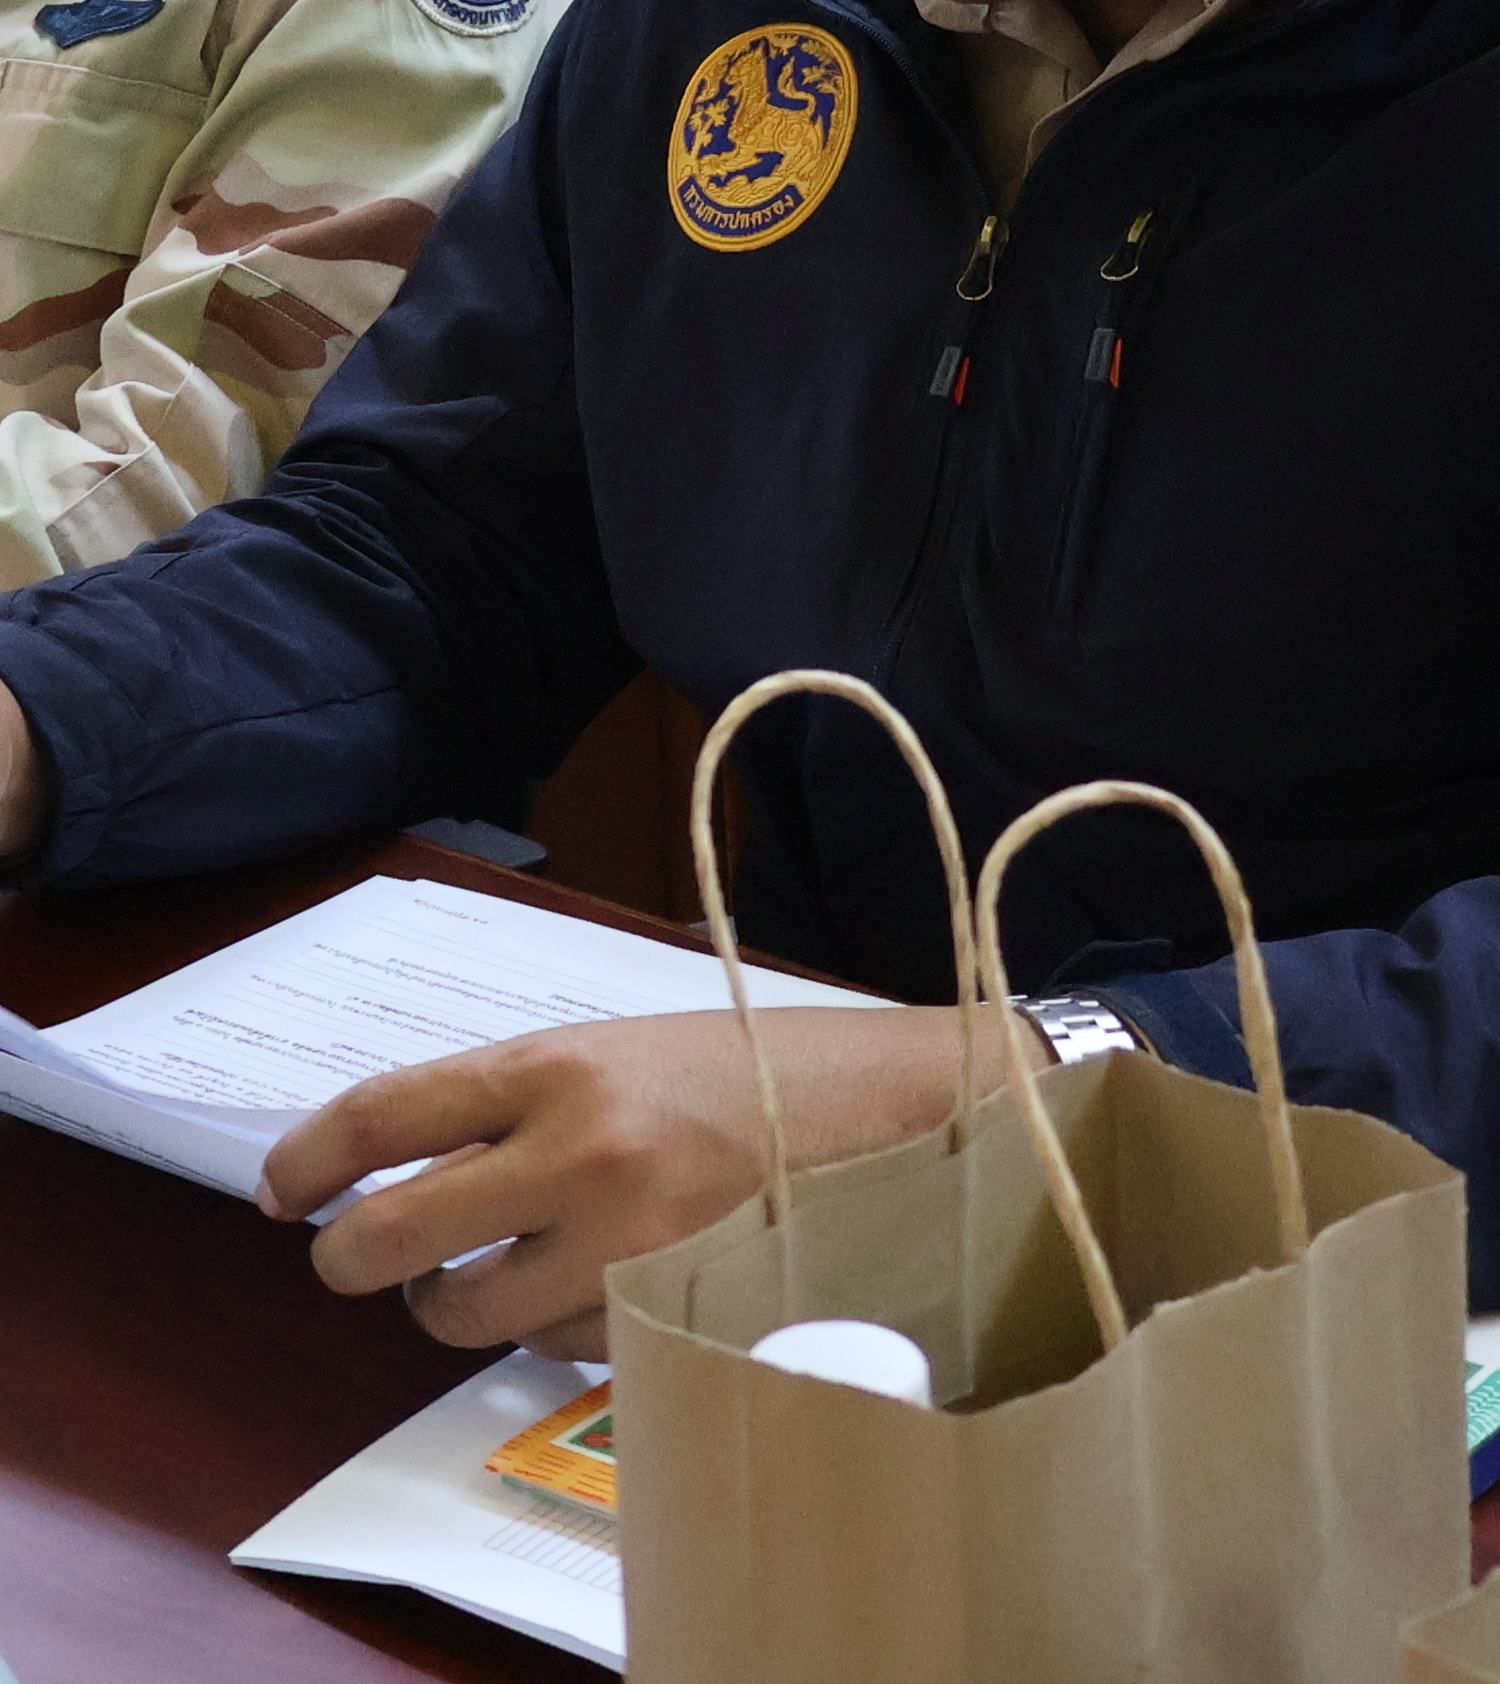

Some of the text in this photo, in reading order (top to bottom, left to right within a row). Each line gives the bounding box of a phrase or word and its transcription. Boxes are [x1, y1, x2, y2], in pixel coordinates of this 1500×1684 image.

[683, 184, 796, 230] กรมการปกครอง
